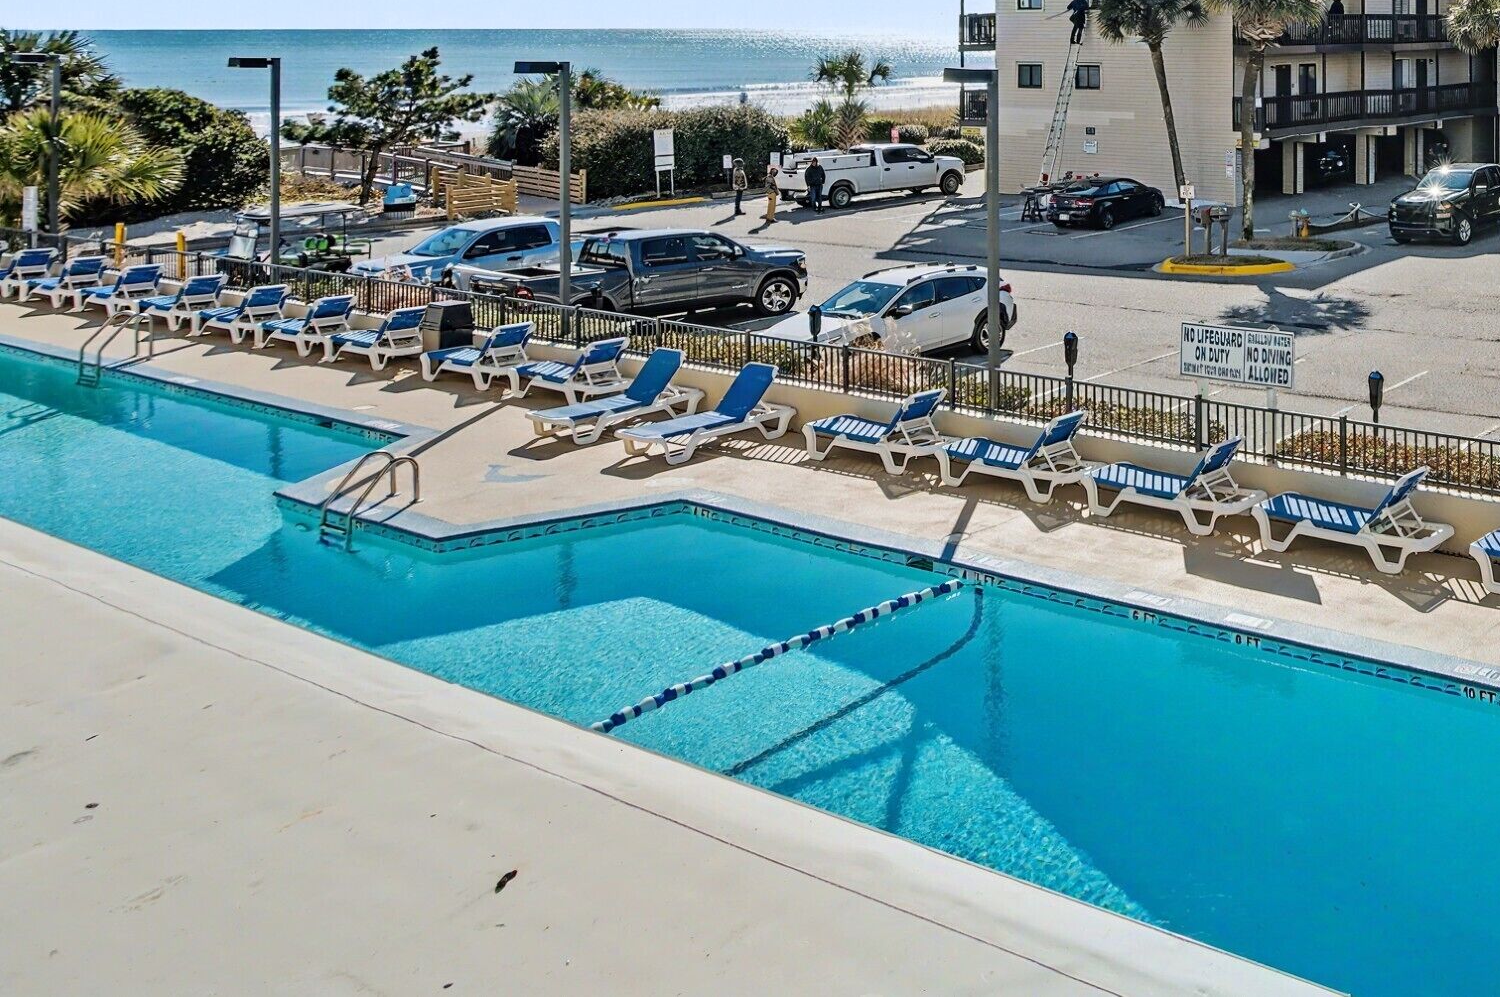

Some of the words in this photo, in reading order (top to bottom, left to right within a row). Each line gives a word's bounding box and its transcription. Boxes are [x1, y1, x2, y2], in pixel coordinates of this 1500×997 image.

[1184, 327, 1195, 342] NO
[1198, 329, 1242, 347] LIFEGUARD
[1195, 346, 1206, 361] ON
[1209, 348, 1230, 364] DUTY
[1247, 347, 1258, 362] NO
[1262, 349, 1291, 366] DIVING
[1248, 366, 1289, 384] ALLOWED
[1247, 637, 1261, 648] FT
[1463, 686, 1475, 699] 10
[1480, 690, 1496, 703] FT
